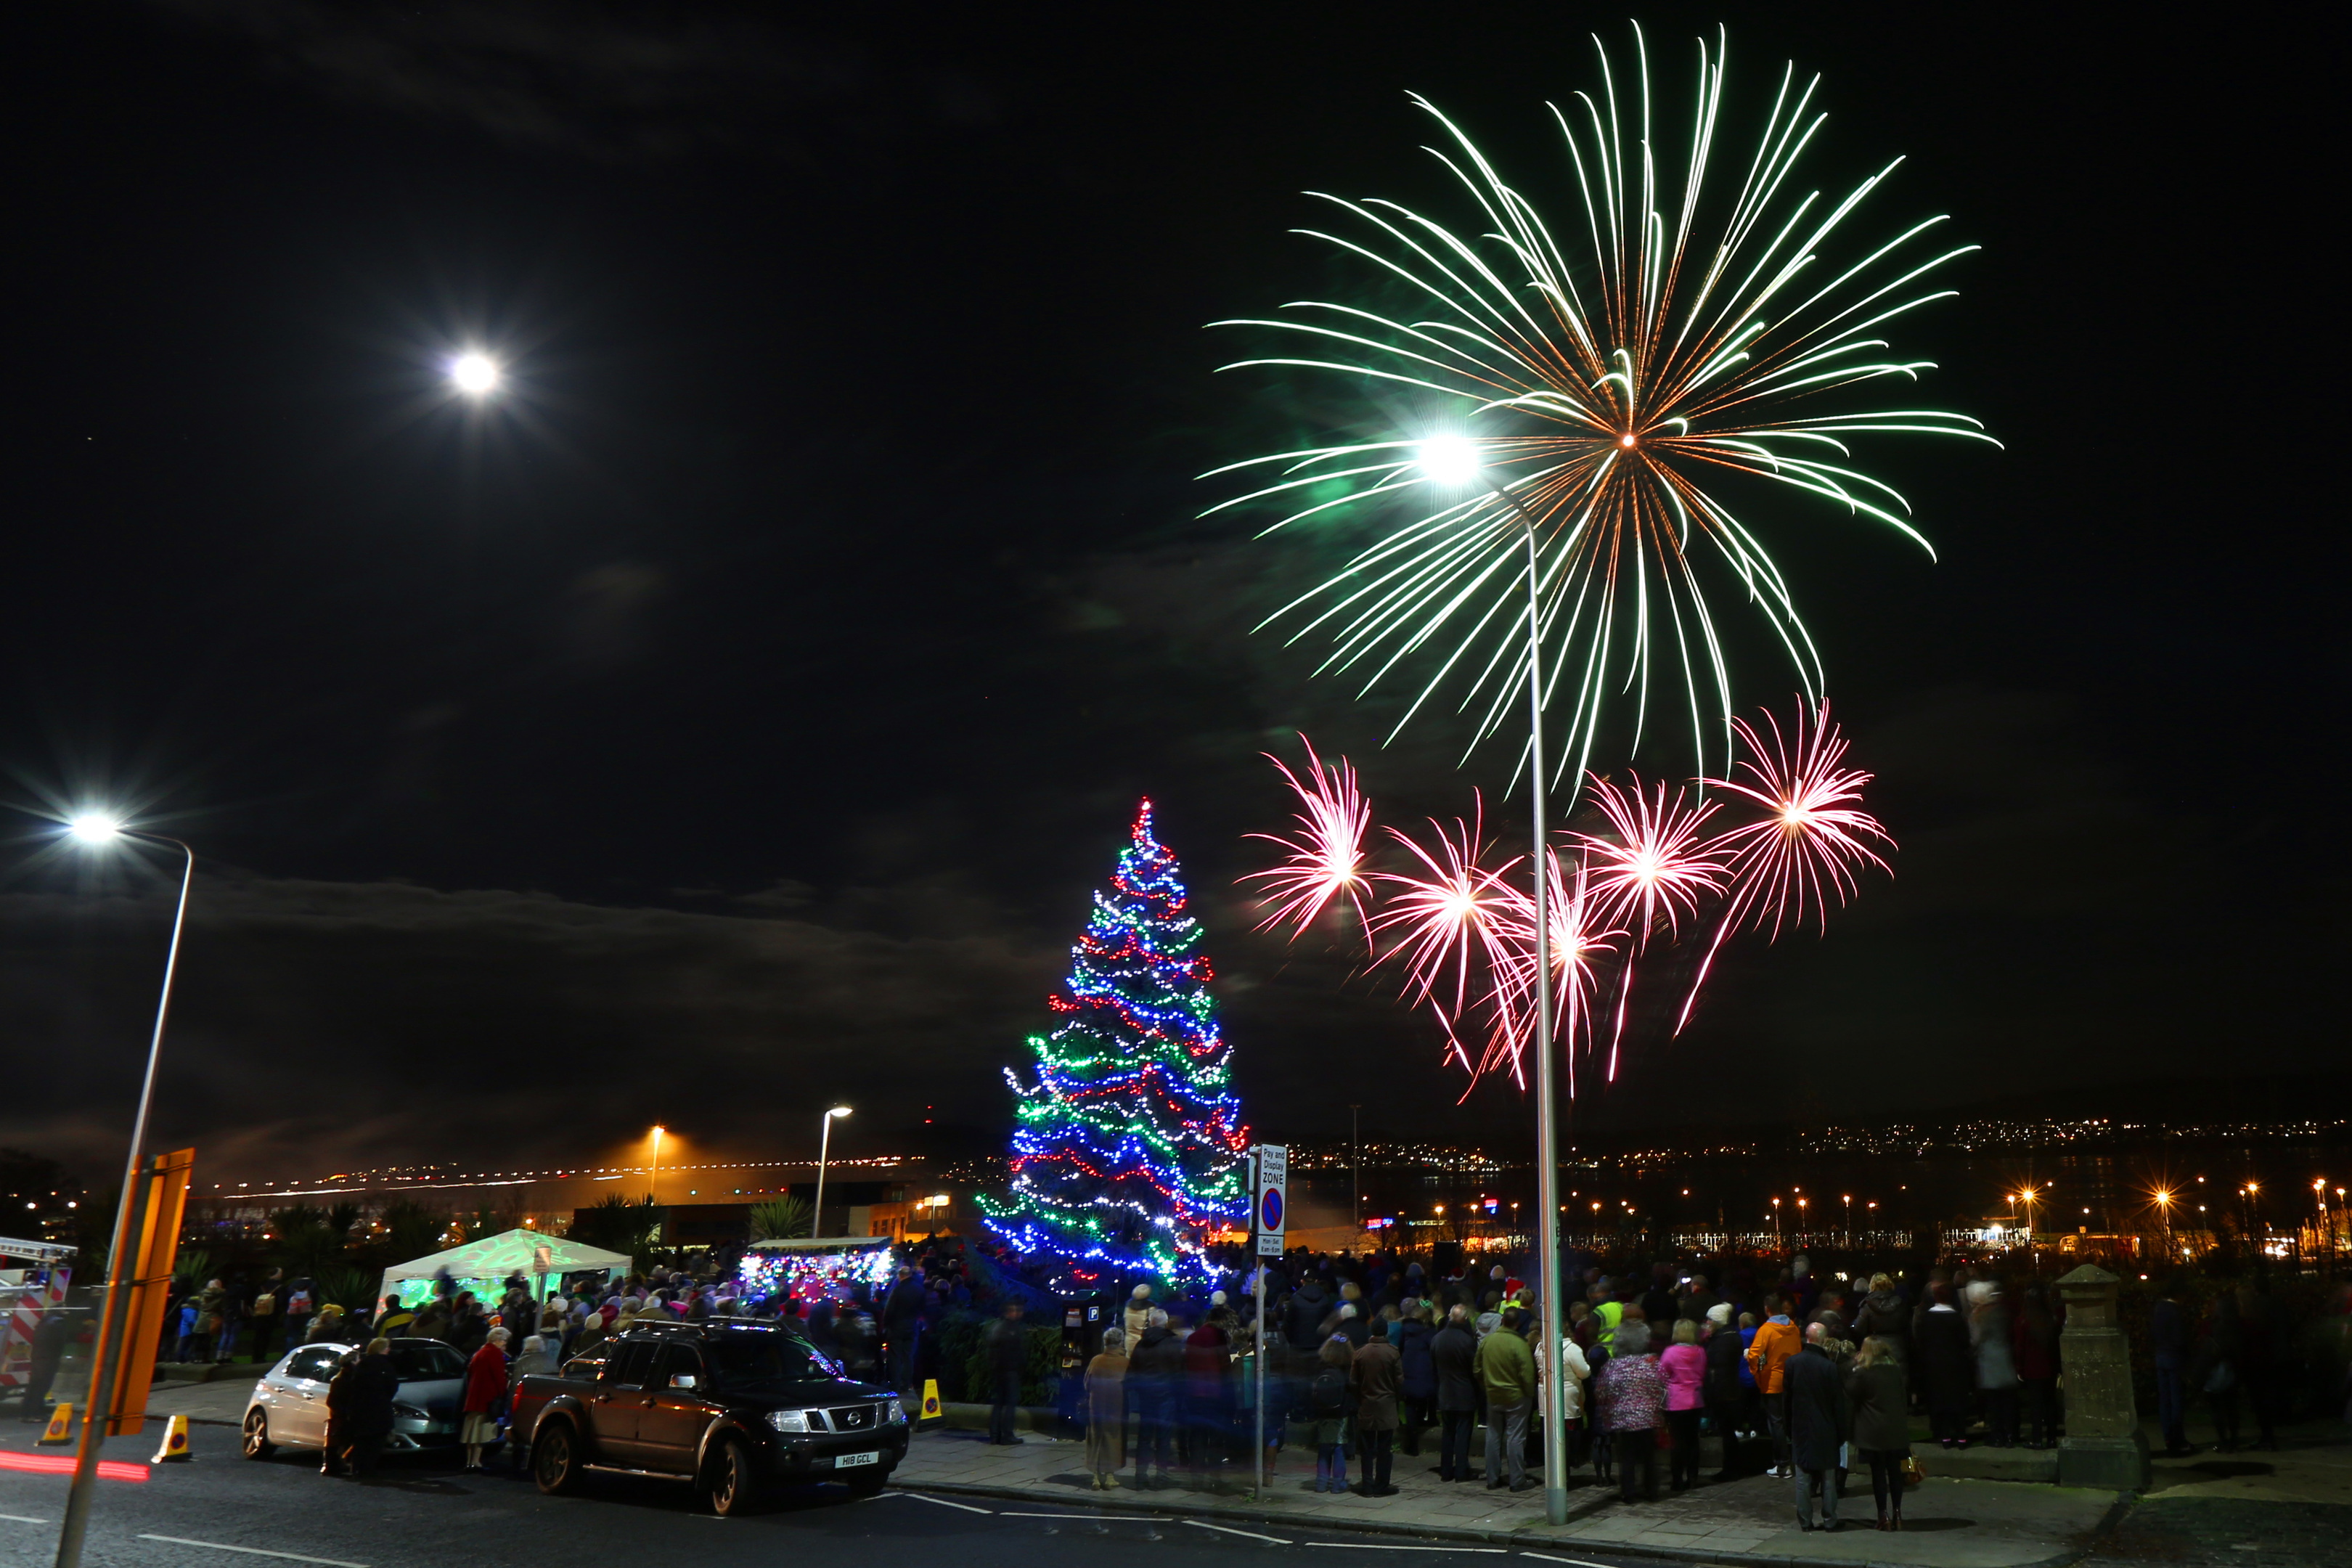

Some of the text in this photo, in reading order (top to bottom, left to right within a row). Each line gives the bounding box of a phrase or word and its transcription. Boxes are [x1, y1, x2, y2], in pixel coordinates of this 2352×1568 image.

[1263, 1148, 1285, 1159] Pay and
[1264, 1159, 1284, 1172] Display
[1263, 1172, 1283, 1185] ZONE
[1091, 1309, 1098, 1319] P
[843, 1454, 871, 1466] H18 GCL
